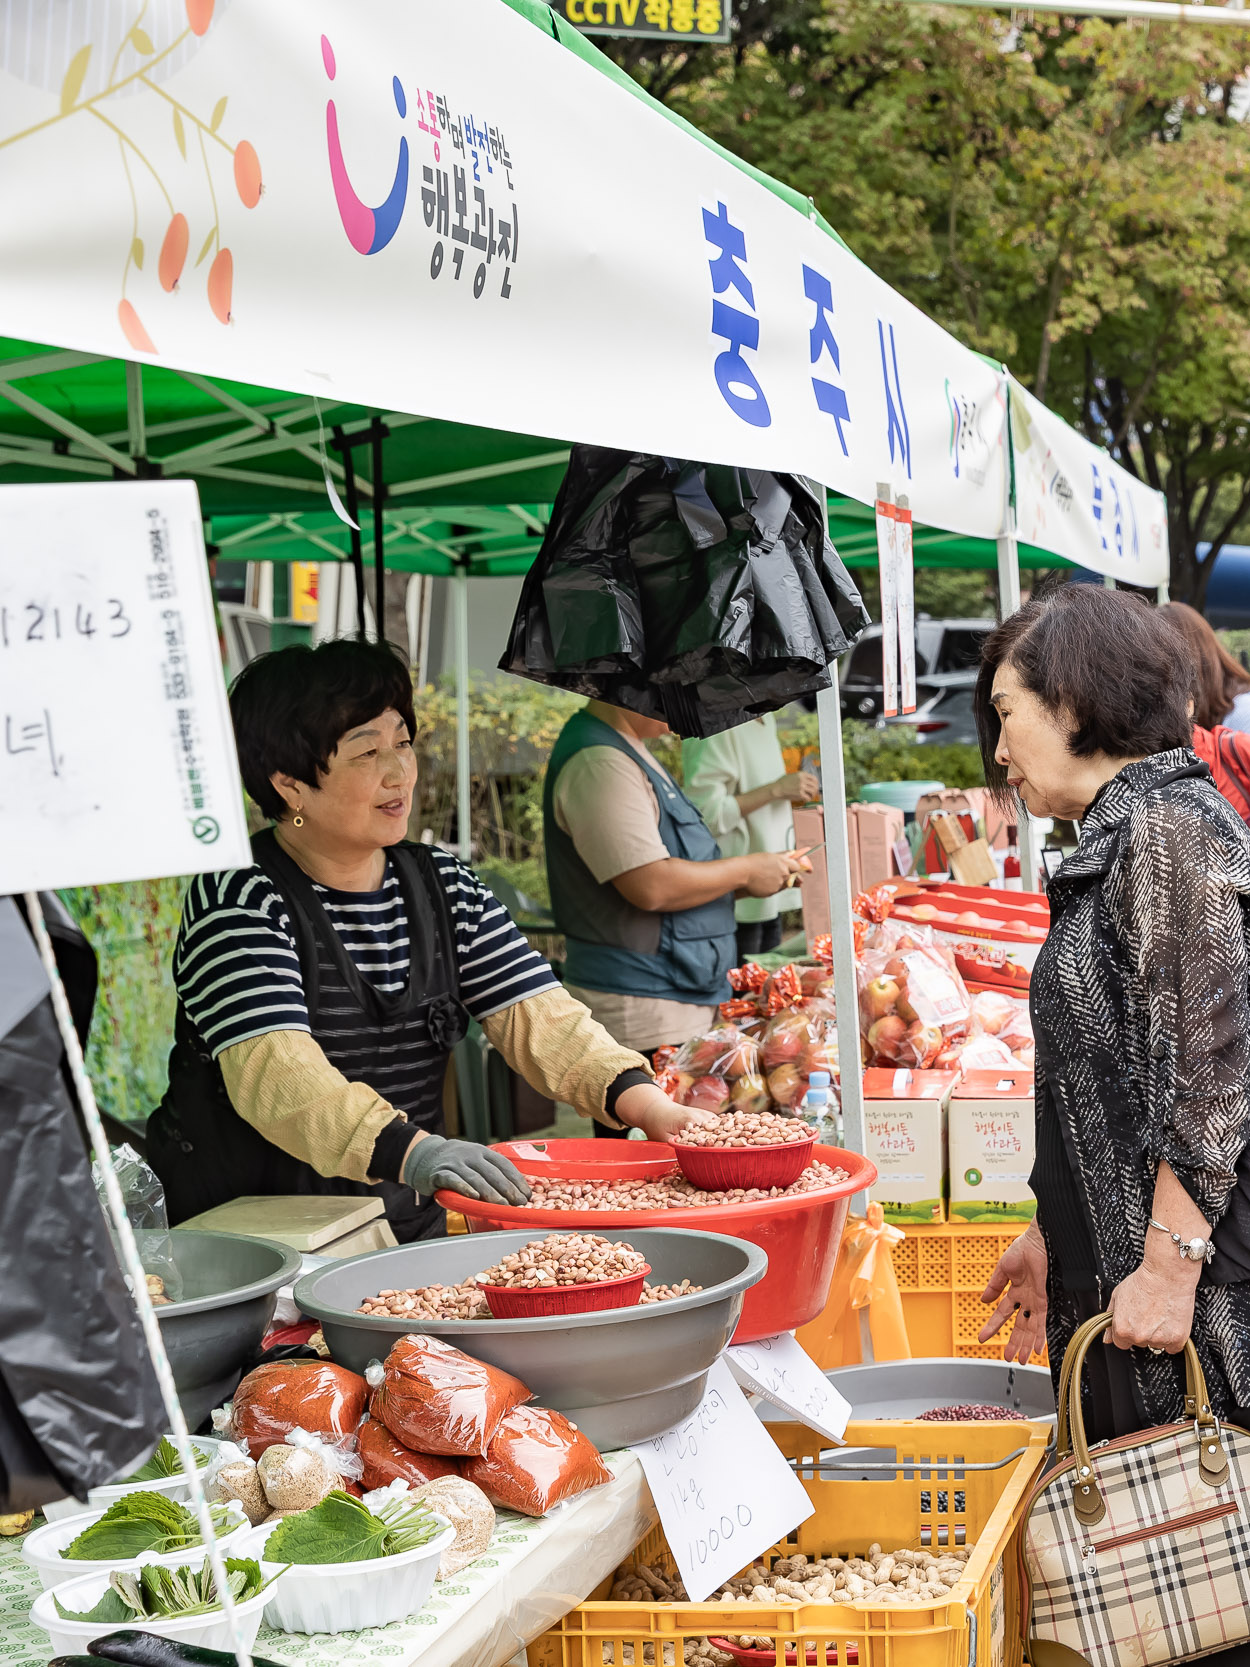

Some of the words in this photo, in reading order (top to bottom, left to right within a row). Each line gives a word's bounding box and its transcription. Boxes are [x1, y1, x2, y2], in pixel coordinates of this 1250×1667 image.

[565, 0, 641, 26] CCTV
[416, 87, 466, 163] 소통하며
[463, 113, 514, 190] 발전하는
[421, 164, 519, 299] 행복광진
[688, 1504, 752, 1572] 10000
